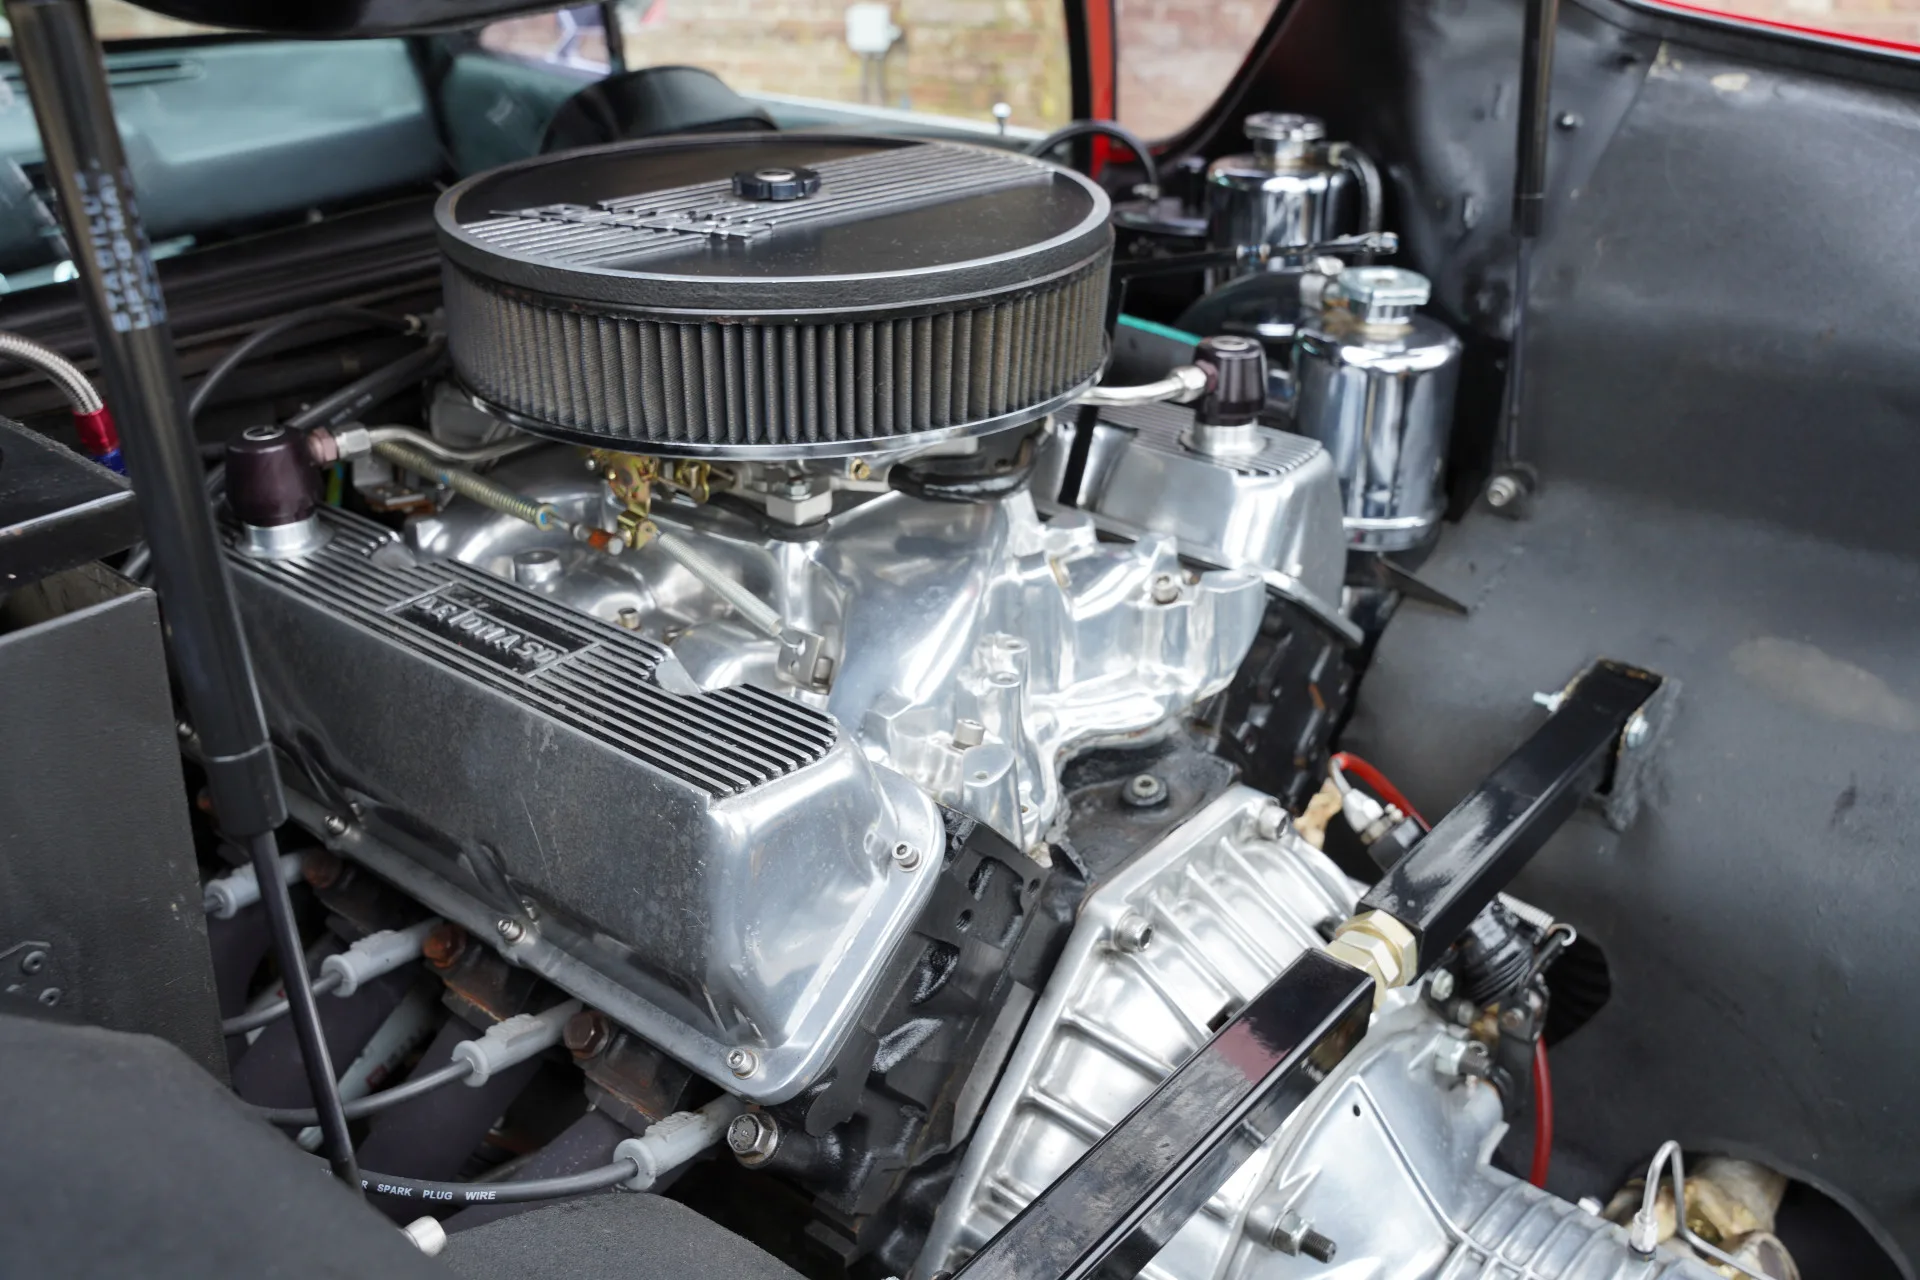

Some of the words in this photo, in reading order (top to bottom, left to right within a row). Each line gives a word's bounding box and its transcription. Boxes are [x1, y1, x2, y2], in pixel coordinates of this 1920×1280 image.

[377, 1183, 413, 1196] SPARK
[422, 1189, 453, 1200] PLUG
[465, 1190, 497, 1201] WIRE
